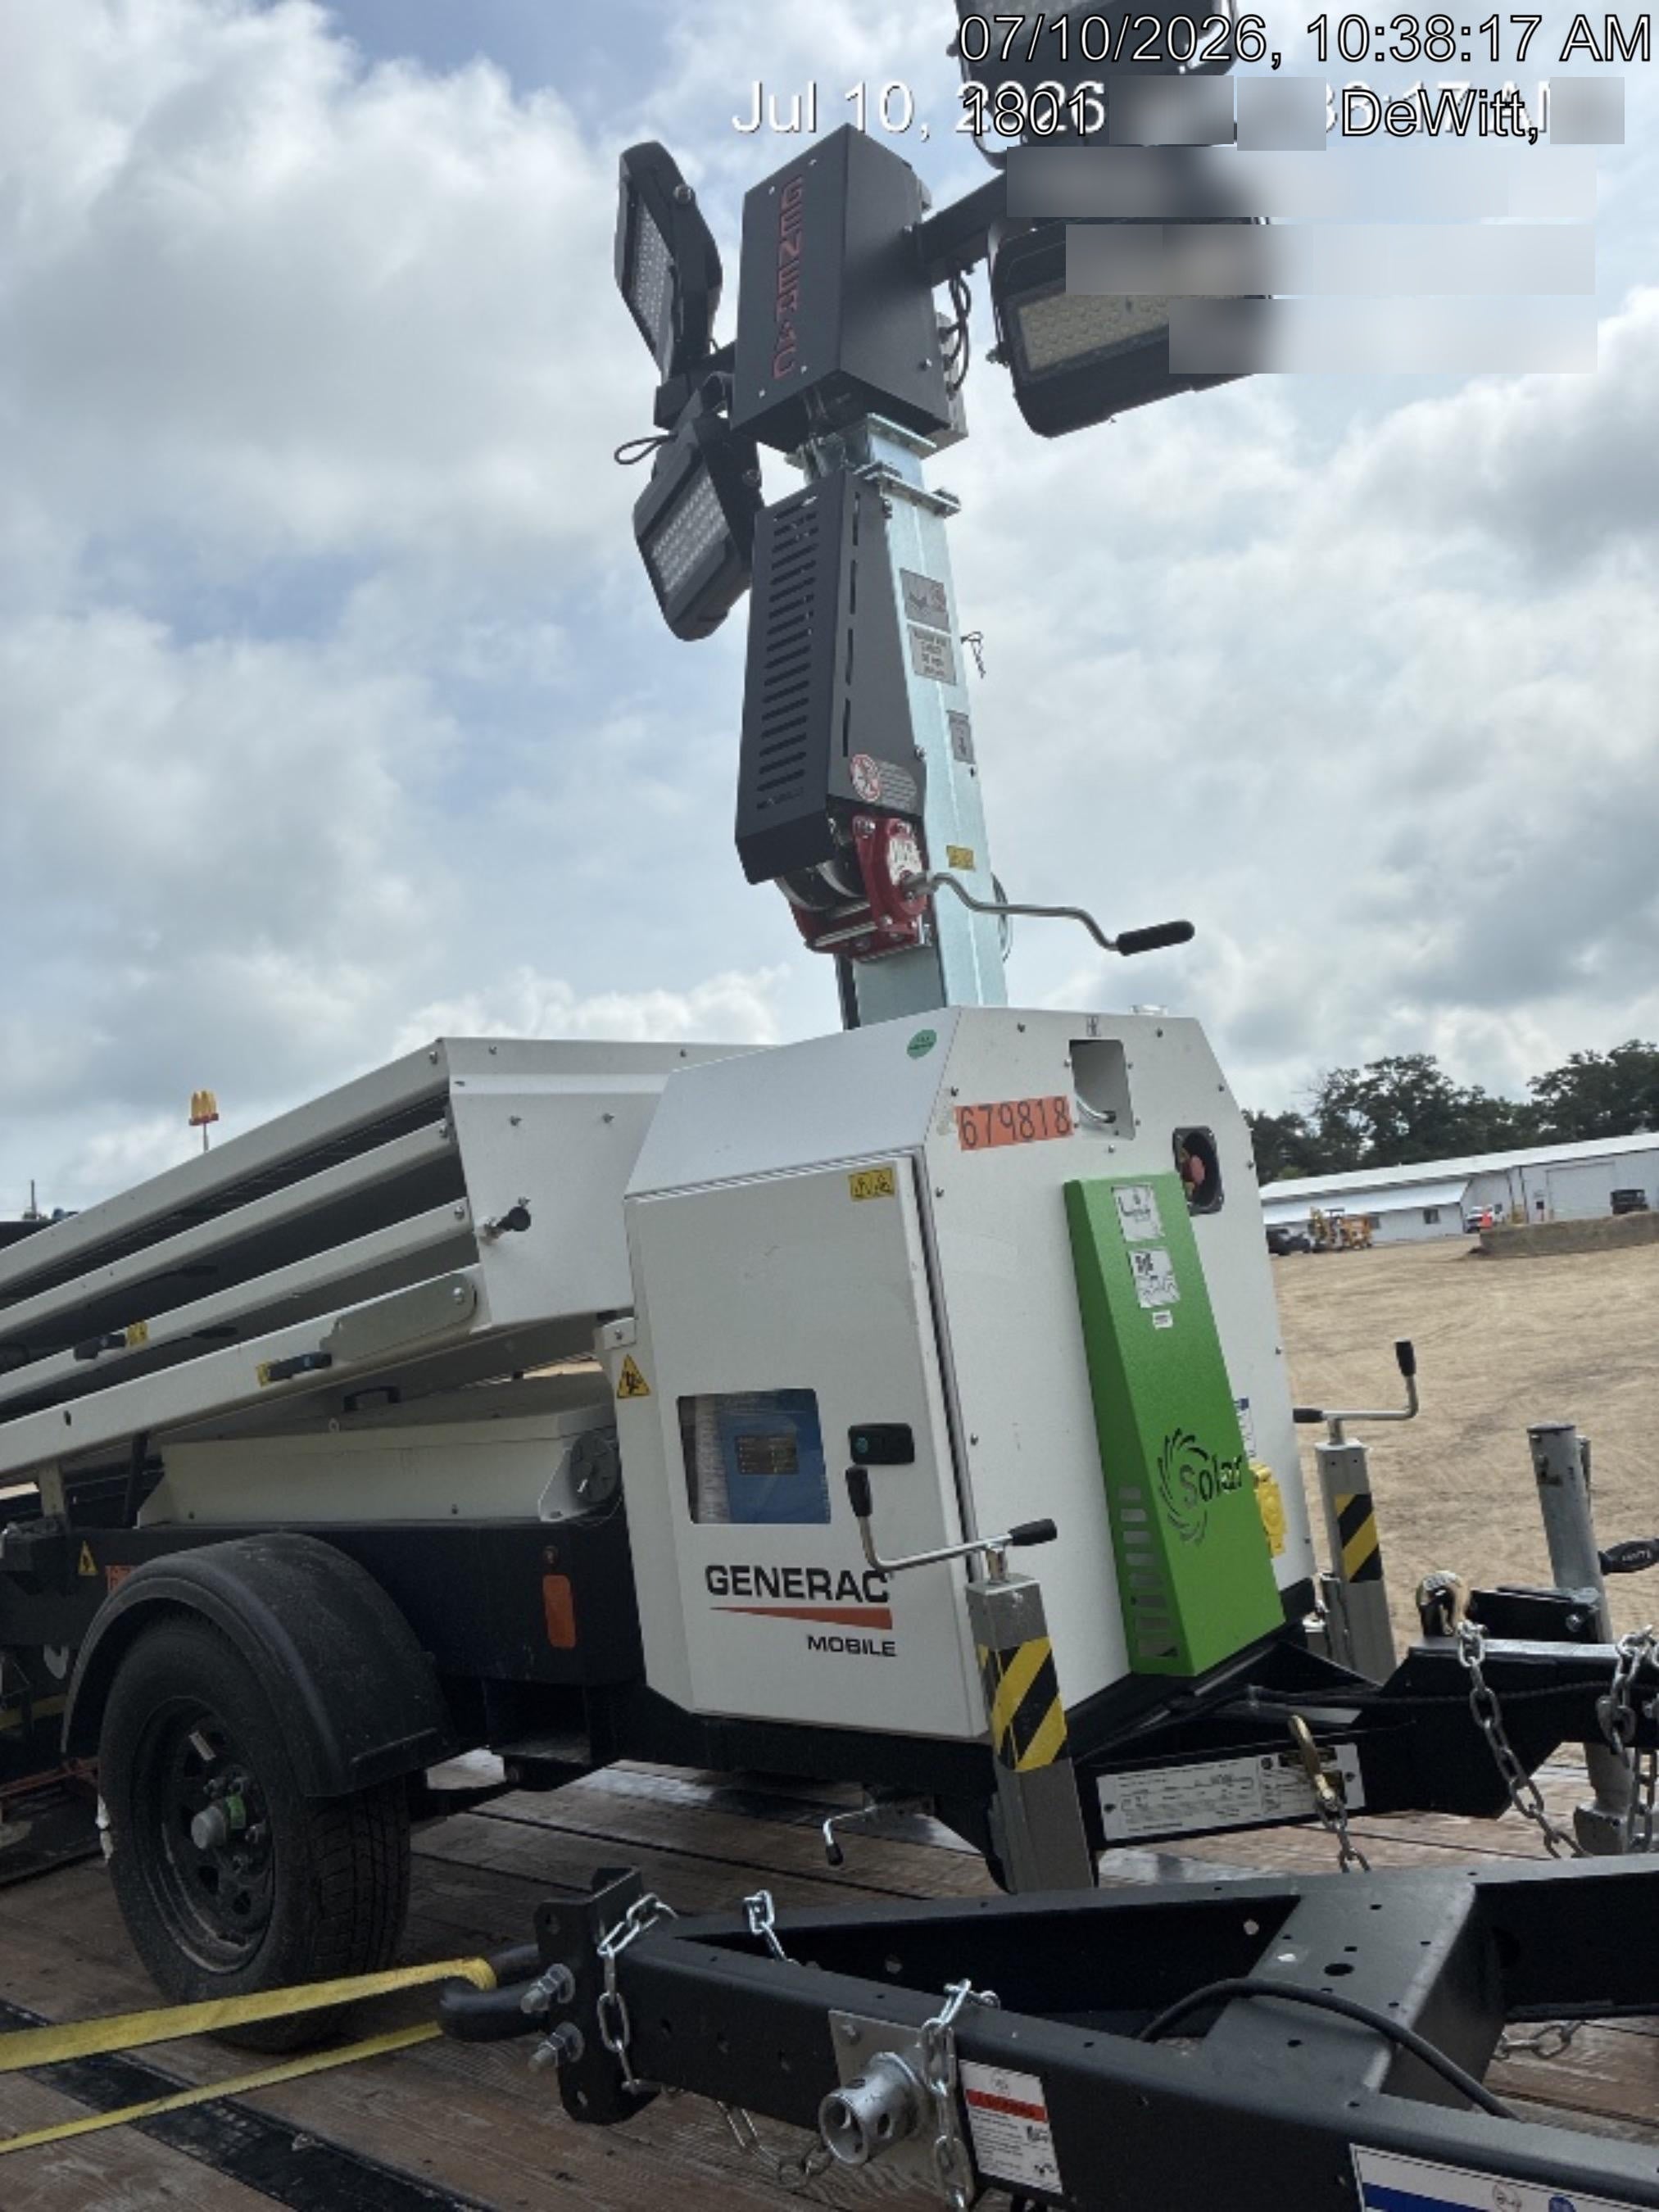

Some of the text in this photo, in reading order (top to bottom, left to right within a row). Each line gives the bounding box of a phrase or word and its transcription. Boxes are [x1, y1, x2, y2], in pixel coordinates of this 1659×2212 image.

[773, 175, 804, 379] GENERAC
[960, 1096, 1071, 1147] 679818
[1180, 1454, 1242, 1509] Solar
[705, 1565, 889, 1603] GENERAC
[807, 1635, 897, 1657] MOBILE
